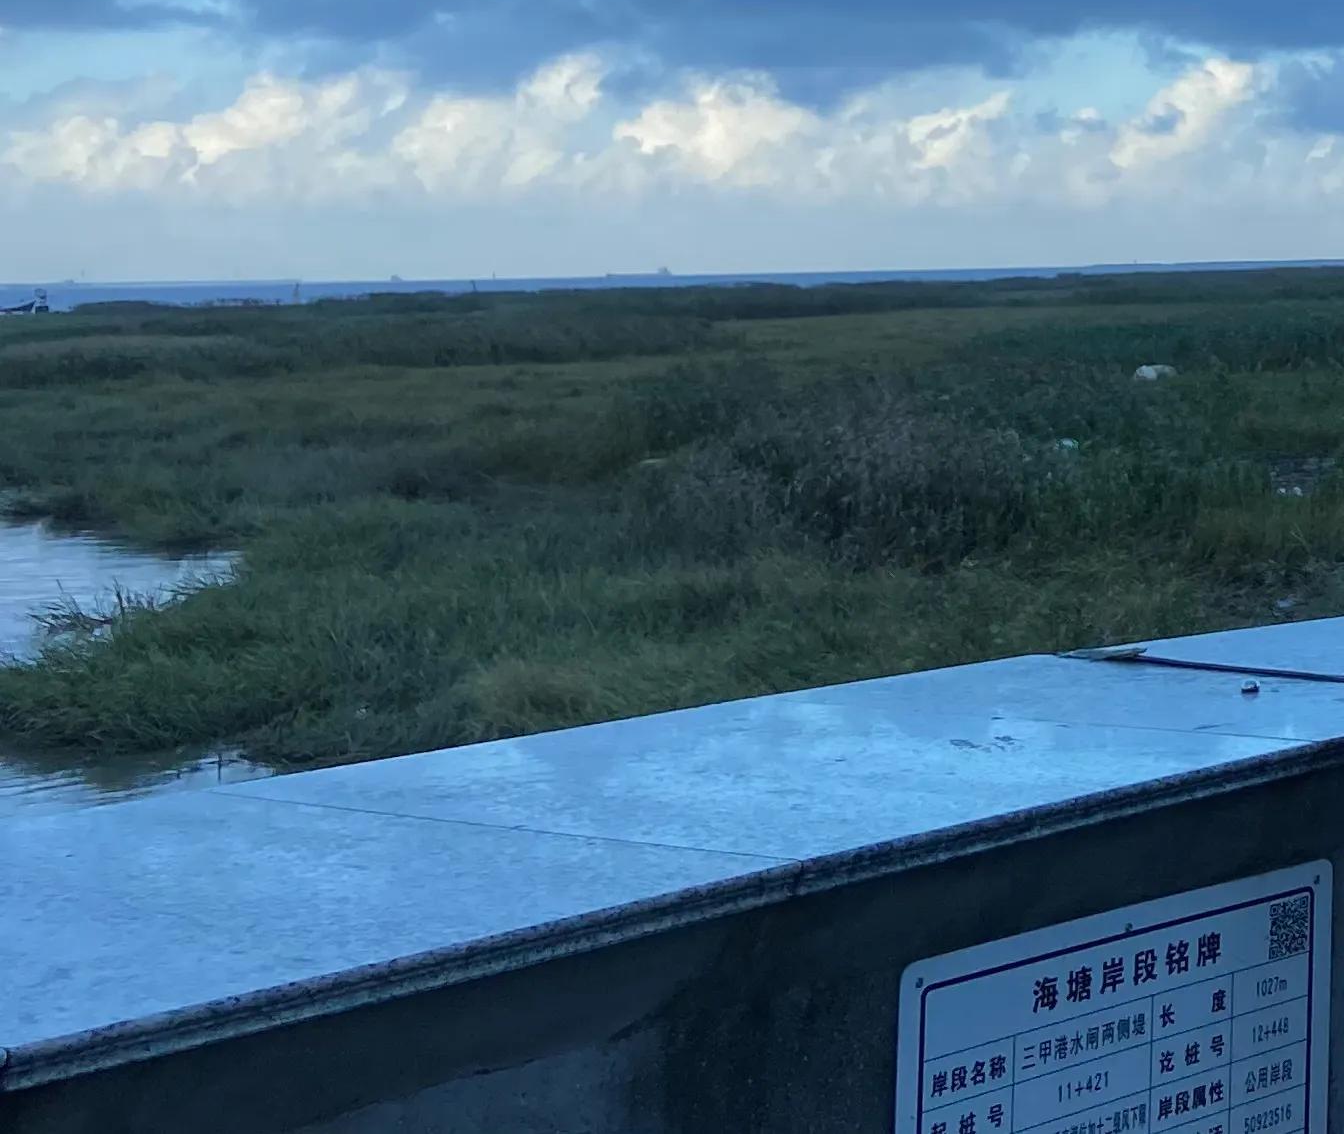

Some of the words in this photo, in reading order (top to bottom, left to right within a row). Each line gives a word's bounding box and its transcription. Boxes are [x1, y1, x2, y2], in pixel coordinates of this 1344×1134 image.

[1032, 931, 1222, 1013] 海塘岸段铭牌
[1256, 976, 1288, 997] 1027m
[1021, 1013, 1146, 1070] 三甲港水闸两侧堤
[1252, 1017, 1289, 1043] 12+448
[931, 1054, 1007, 1098] 岸段名称
[1057, 1070, 1109, 1103] 11+421
[1244, 1058, 1293, 1094] 公用岸段
[1157, 1079, 1225, 1121] 岸段属性
